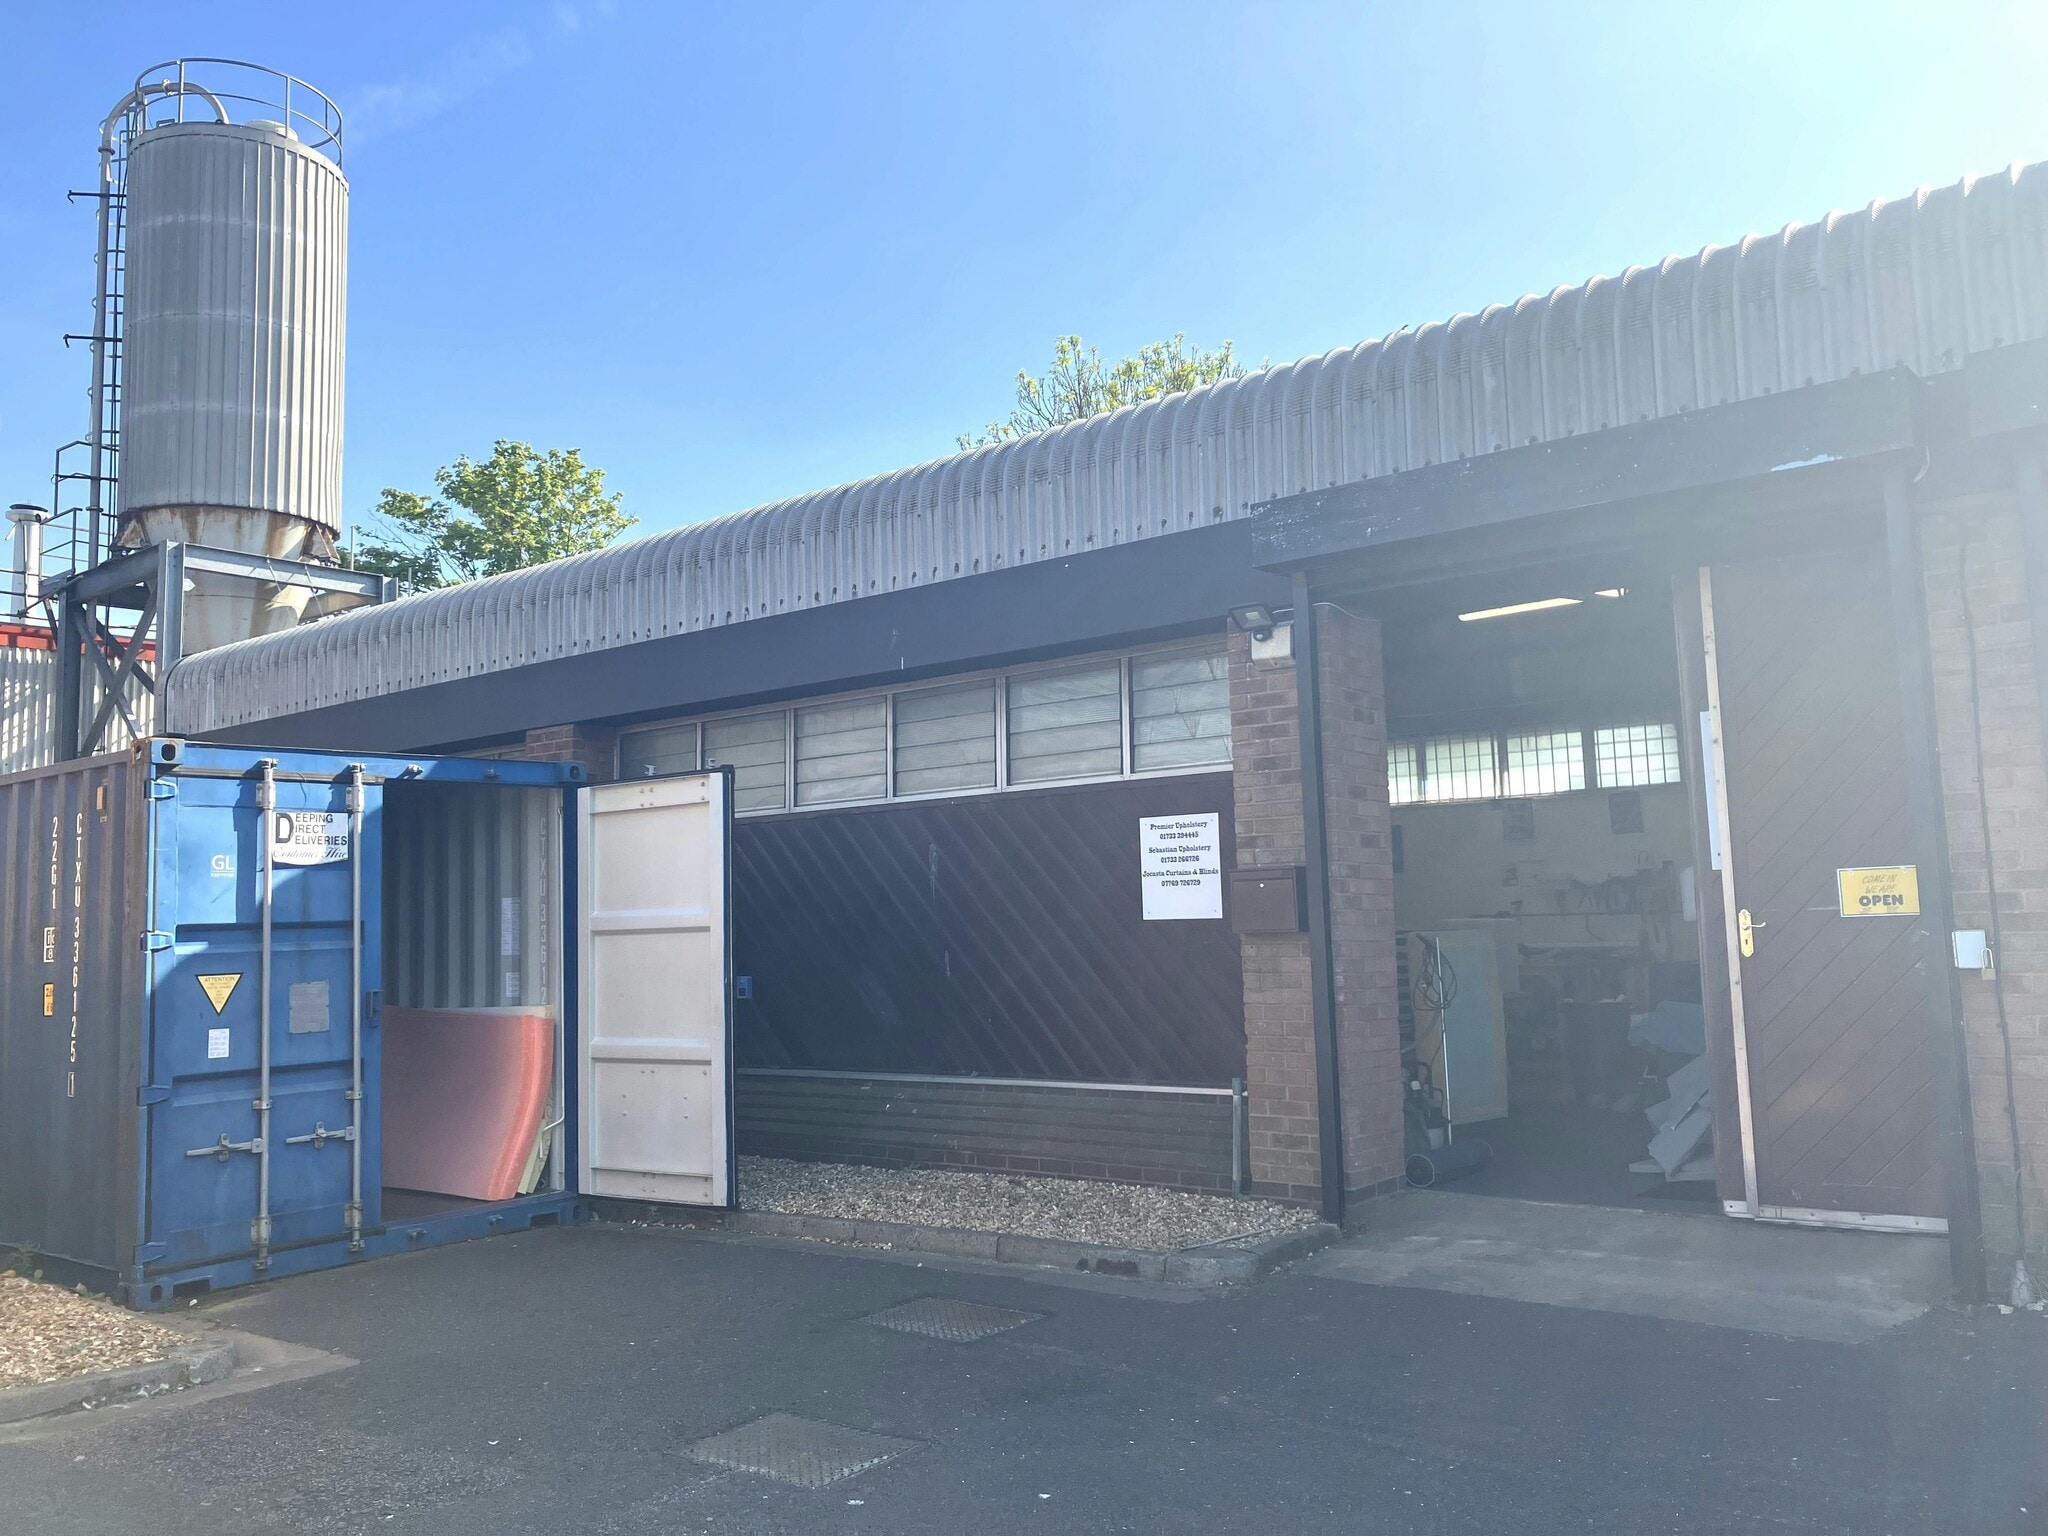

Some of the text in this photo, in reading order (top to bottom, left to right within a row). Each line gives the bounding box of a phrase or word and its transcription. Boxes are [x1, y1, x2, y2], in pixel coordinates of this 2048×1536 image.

[1175, 821, 1208, 829] Upholstery
[272, 847, 347, 858] Containe Hire
[1148, 844, 1212, 854] Sebastian Upholstery
[51, 816, 59, 910] 22G1
[75, 812, 83, 908] CTXU
[211, 854, 235, 871] GL
[539, 817, 547, 897] CTXU
[1198, 867, 1219, 875] Blinds
[1862, 873, 1898, 884] COME IN
[1865, 884, 1897, 894] WE ARE
[1859, 894, 1904, 907] OPEN
[70, 917, 81, 1063] 336125
